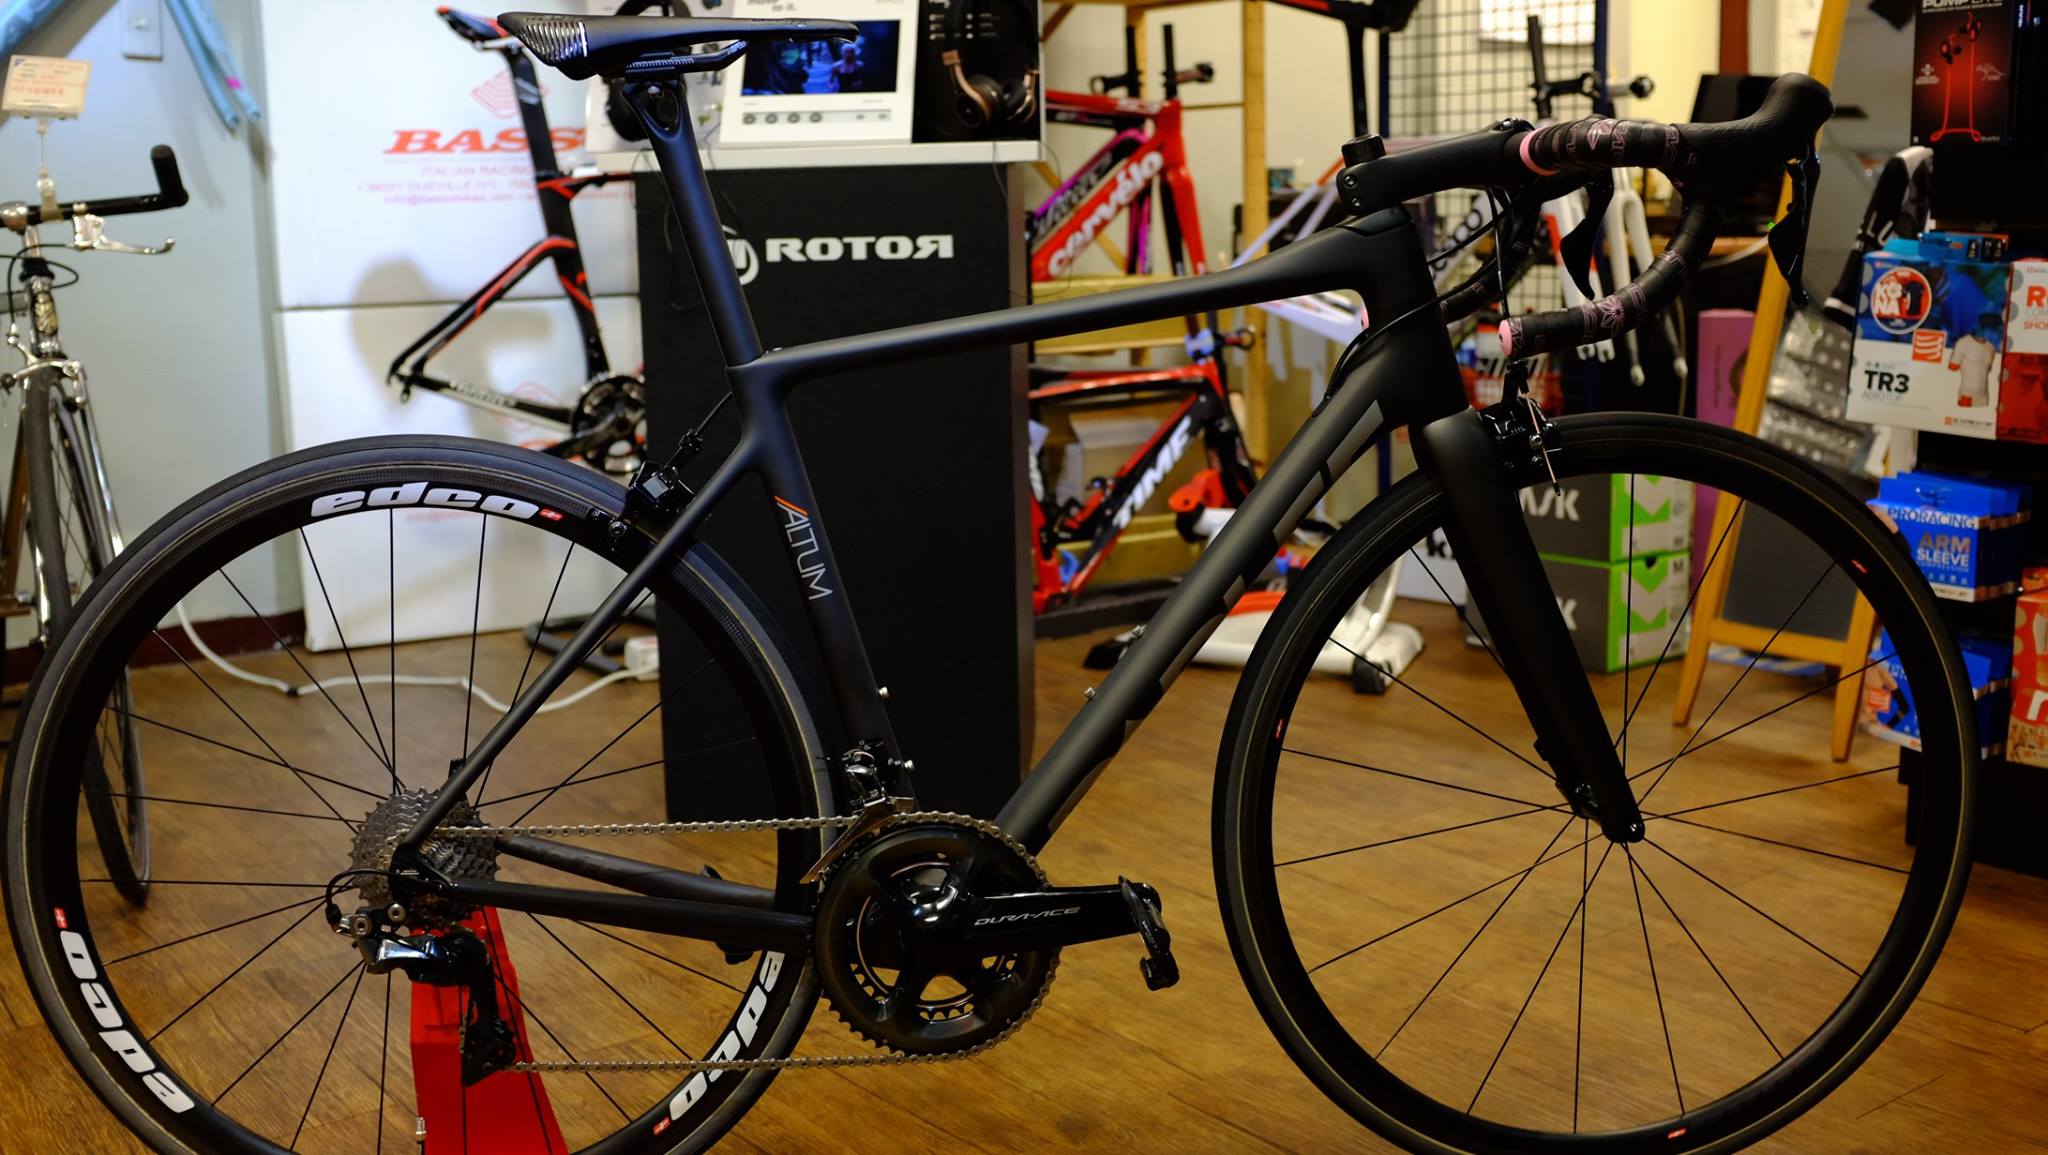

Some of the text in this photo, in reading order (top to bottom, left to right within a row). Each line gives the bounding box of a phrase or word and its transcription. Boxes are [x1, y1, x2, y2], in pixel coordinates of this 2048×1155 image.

[384, 128, 586, 154] BASS
[766, 234, 954, 262] ROTOR
[1864, 369, 1911, 394] TR3
[310, 481, 541, 519] edco
[1519, 487, 1580, 522] ASK
[775, 495, 834, 600] ALTUM
[1919, 532, 1971, 554] ARM
[1917, 547, 1970, 568] SLEEVE
[974, 906, 1081, 926] DURA-ACE
[60, 930, 195, 1113] edco
